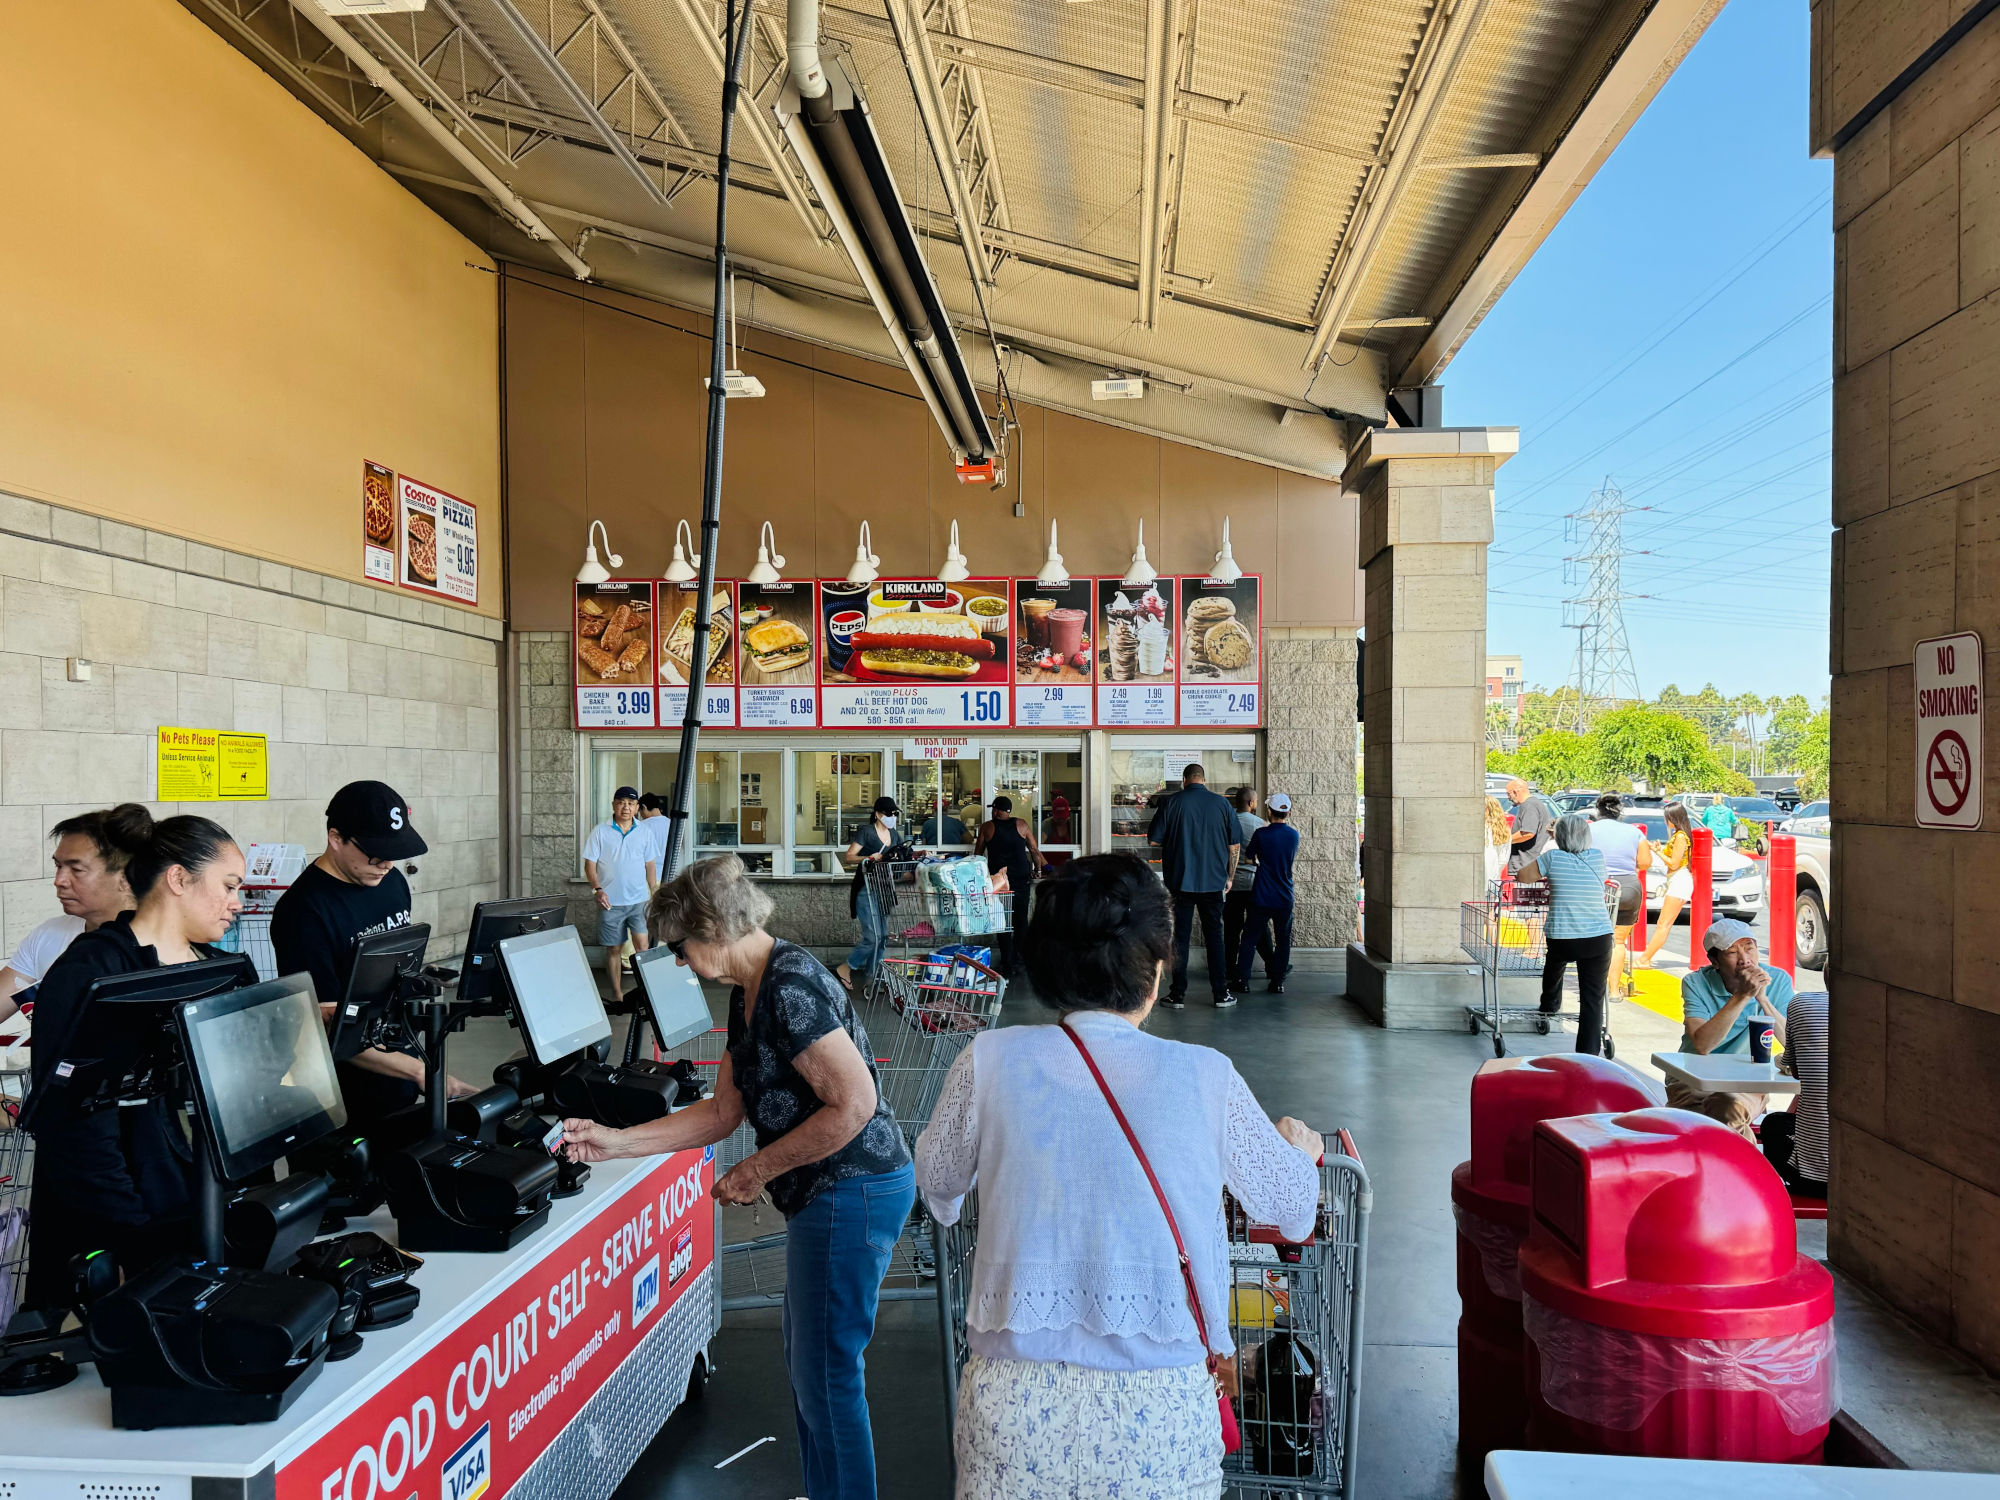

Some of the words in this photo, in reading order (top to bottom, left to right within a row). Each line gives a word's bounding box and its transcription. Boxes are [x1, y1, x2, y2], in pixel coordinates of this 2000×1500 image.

[404, 484, 436, 507] COSTCO
[442, 506, 474, 530] PIZZA!
[457, 544, 474, 577] 9.95
[885, 583, 944, 593] KIRKLAND
[832, 622, 864, 632] PEPSI
[1936, 645, 1955, 676] NO
[617, 691, 650, 714] 3.99
[1044, 688, 1063, 700] 2.99
[1112, 688, 1127, 699] 2.49
[1148, 688, 1162, 699] 1.99
[1228, 693, 1254, 712] 2.49
[1920, 684, 1978, 719] SMOKING
[708, 698, 729, 714] 6.99
[791, 699, 813, 714] 6.99
[960, 690, 1001, 722] 1.50
[867, 716, 881, 724] 580
[889, 716, 903, 724] 850
[905, 716, 918, 724] cal.
[162, 732, 170, 743] No
[174, 732, 189, 744] Pets
[192, 734, 215, 745] Please
[914, 738, 939, 746] KIOSK
[942, 738, 968, 746] ORDER
[197, 754, 214, 762] Animals
[924, 748, 958, 758] PICK-UP
[390, 806, 403, 830] S
[1229, 1247, 1264, 1255] HICKEN
[669, 1242, 692, 1282] shop
[634, 1267, 658, 1316] ATM
[322, 1394, 436, 1500] FOOD
[446, 1296, 541, 1430] COURT
[547, 1205, 653, 1340] SELF-SERVE
[659, 1158, 703, 1235] KIOSK
[509, 1374, 559, 1442] Electronic
[560, 1328, 603, 1392] payments
[604, 1310, 621, 1346] only
[449, 1448, 484, 1500] VISA
